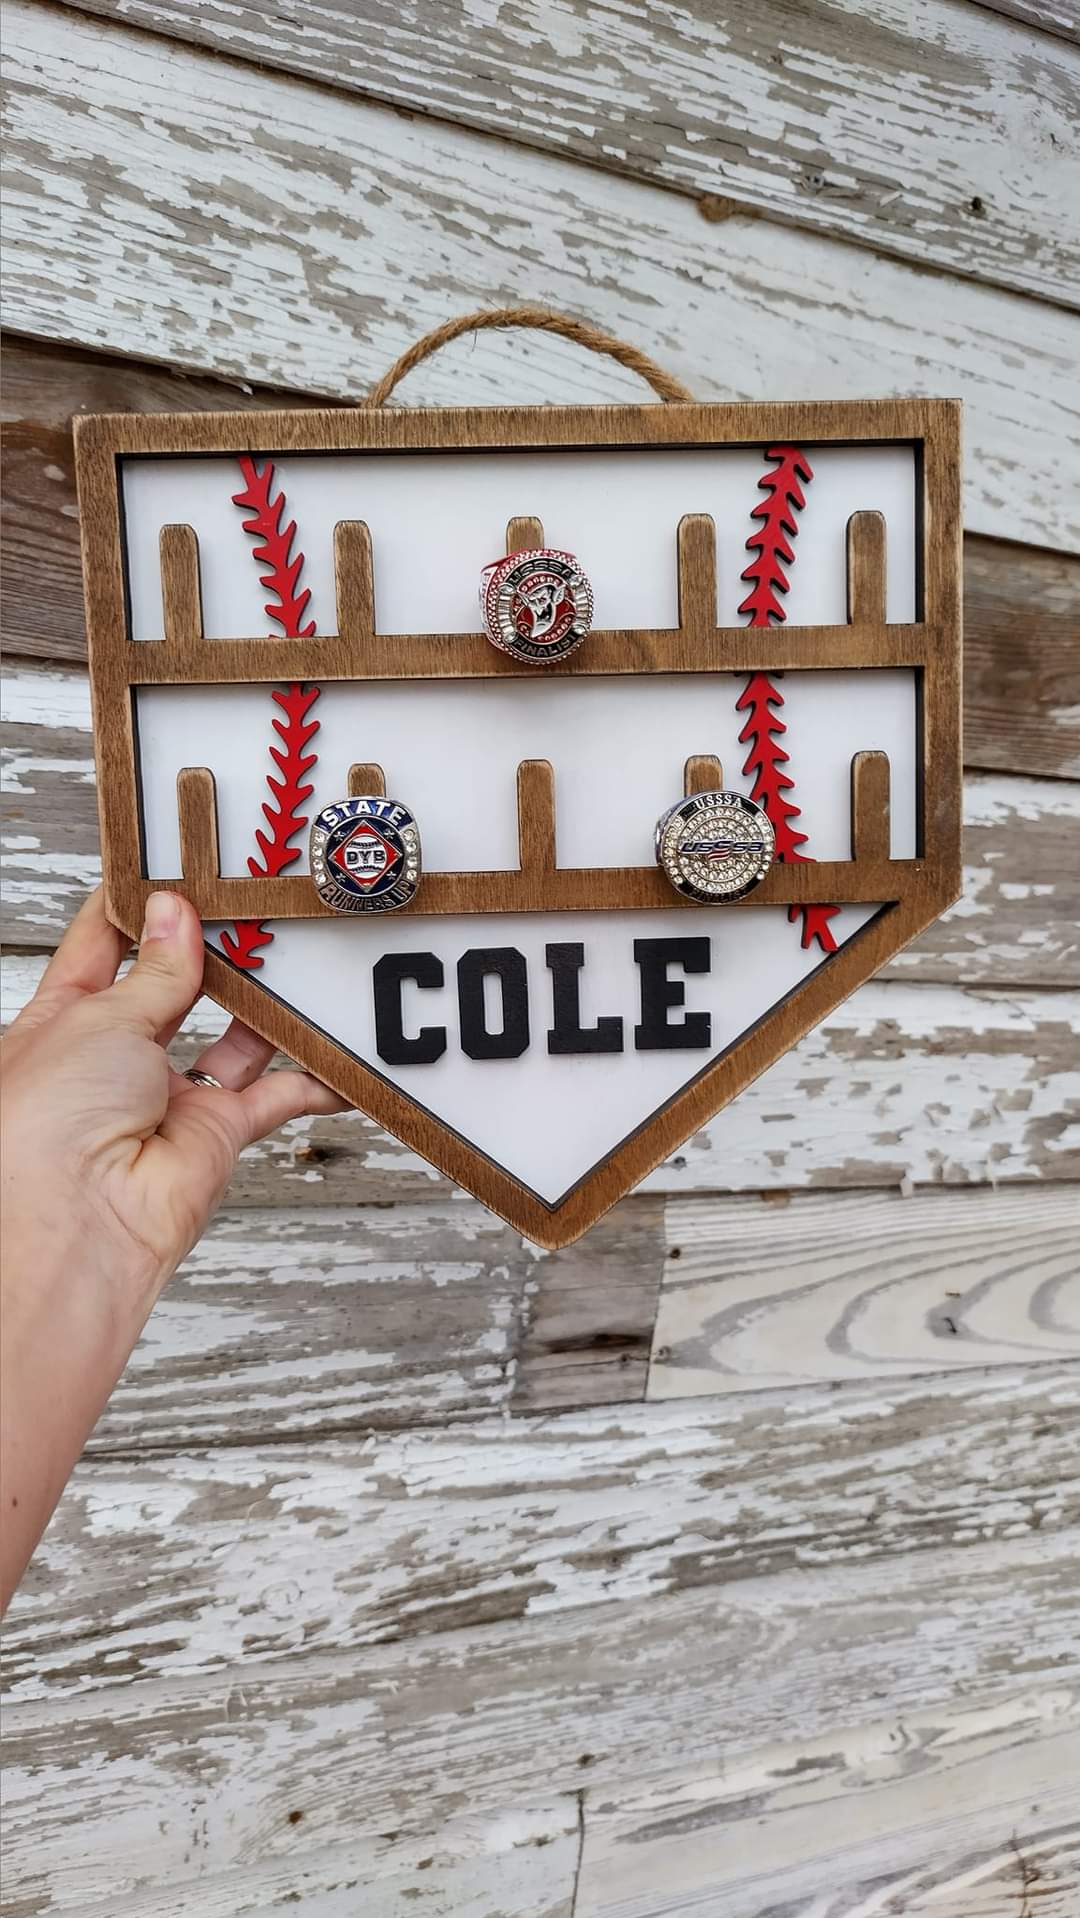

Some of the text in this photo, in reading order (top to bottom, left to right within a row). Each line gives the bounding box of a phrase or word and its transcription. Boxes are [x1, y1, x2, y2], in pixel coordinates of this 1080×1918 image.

[509, 560, 573, 584] USSSA
[514, 633, 577, 657] FINALIST
[321, 800, 406, 827] STATE
[694, 794, 743, 809] USSSA
[346, 849, 386, 864] DYB
[320, 880, 413, 911] RUNNERS UP
[373, 937, 712, 1065] COLE
